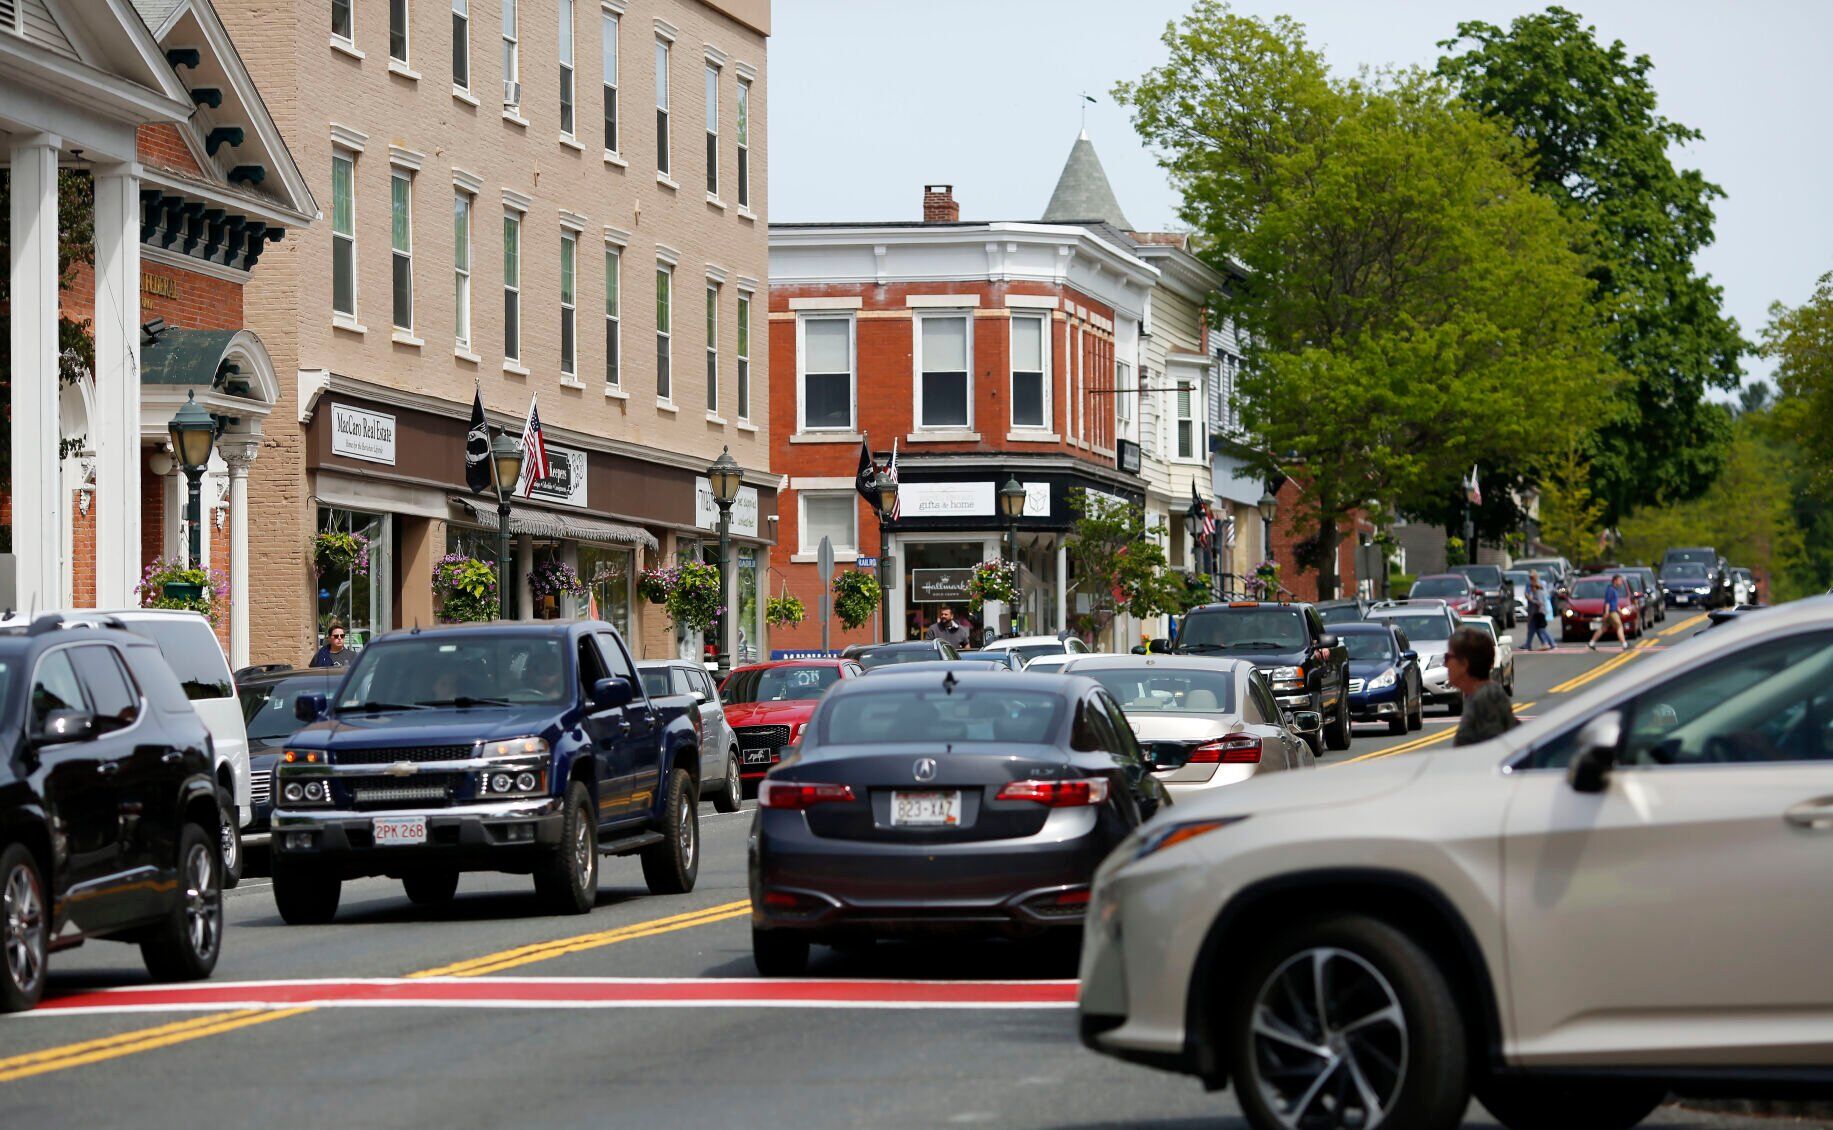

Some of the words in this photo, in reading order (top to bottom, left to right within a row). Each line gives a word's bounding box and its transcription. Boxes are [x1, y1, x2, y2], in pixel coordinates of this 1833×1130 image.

[337, 412, 362, 437] MacCaro
[363, 417, 376, 440] Real
[376, 420, 392, 443] Estate
[549, 461, 567, 483] Keepers
[919, 499, 940, 511] gifts
[950, 499, 975, 509] home
[921, 580, 966, 595] Hallmark
[376, 824, 399, 839] 2PK
[401, 824, 424, 838] 268
